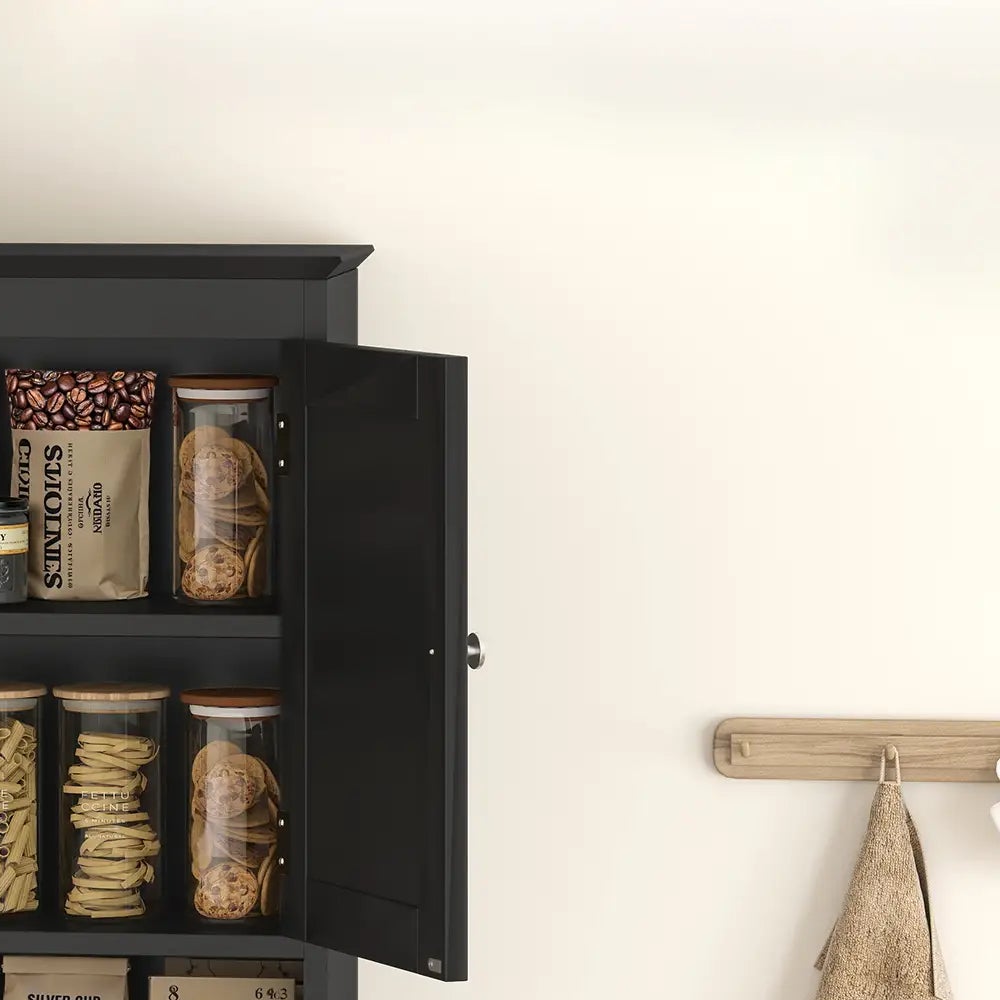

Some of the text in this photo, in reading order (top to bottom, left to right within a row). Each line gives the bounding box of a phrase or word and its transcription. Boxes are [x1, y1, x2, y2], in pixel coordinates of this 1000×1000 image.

[81, 791, 130, 799] FETTU
[81, 803, 129, 811] CCINE
[168, 984, 179, 1000] 8
